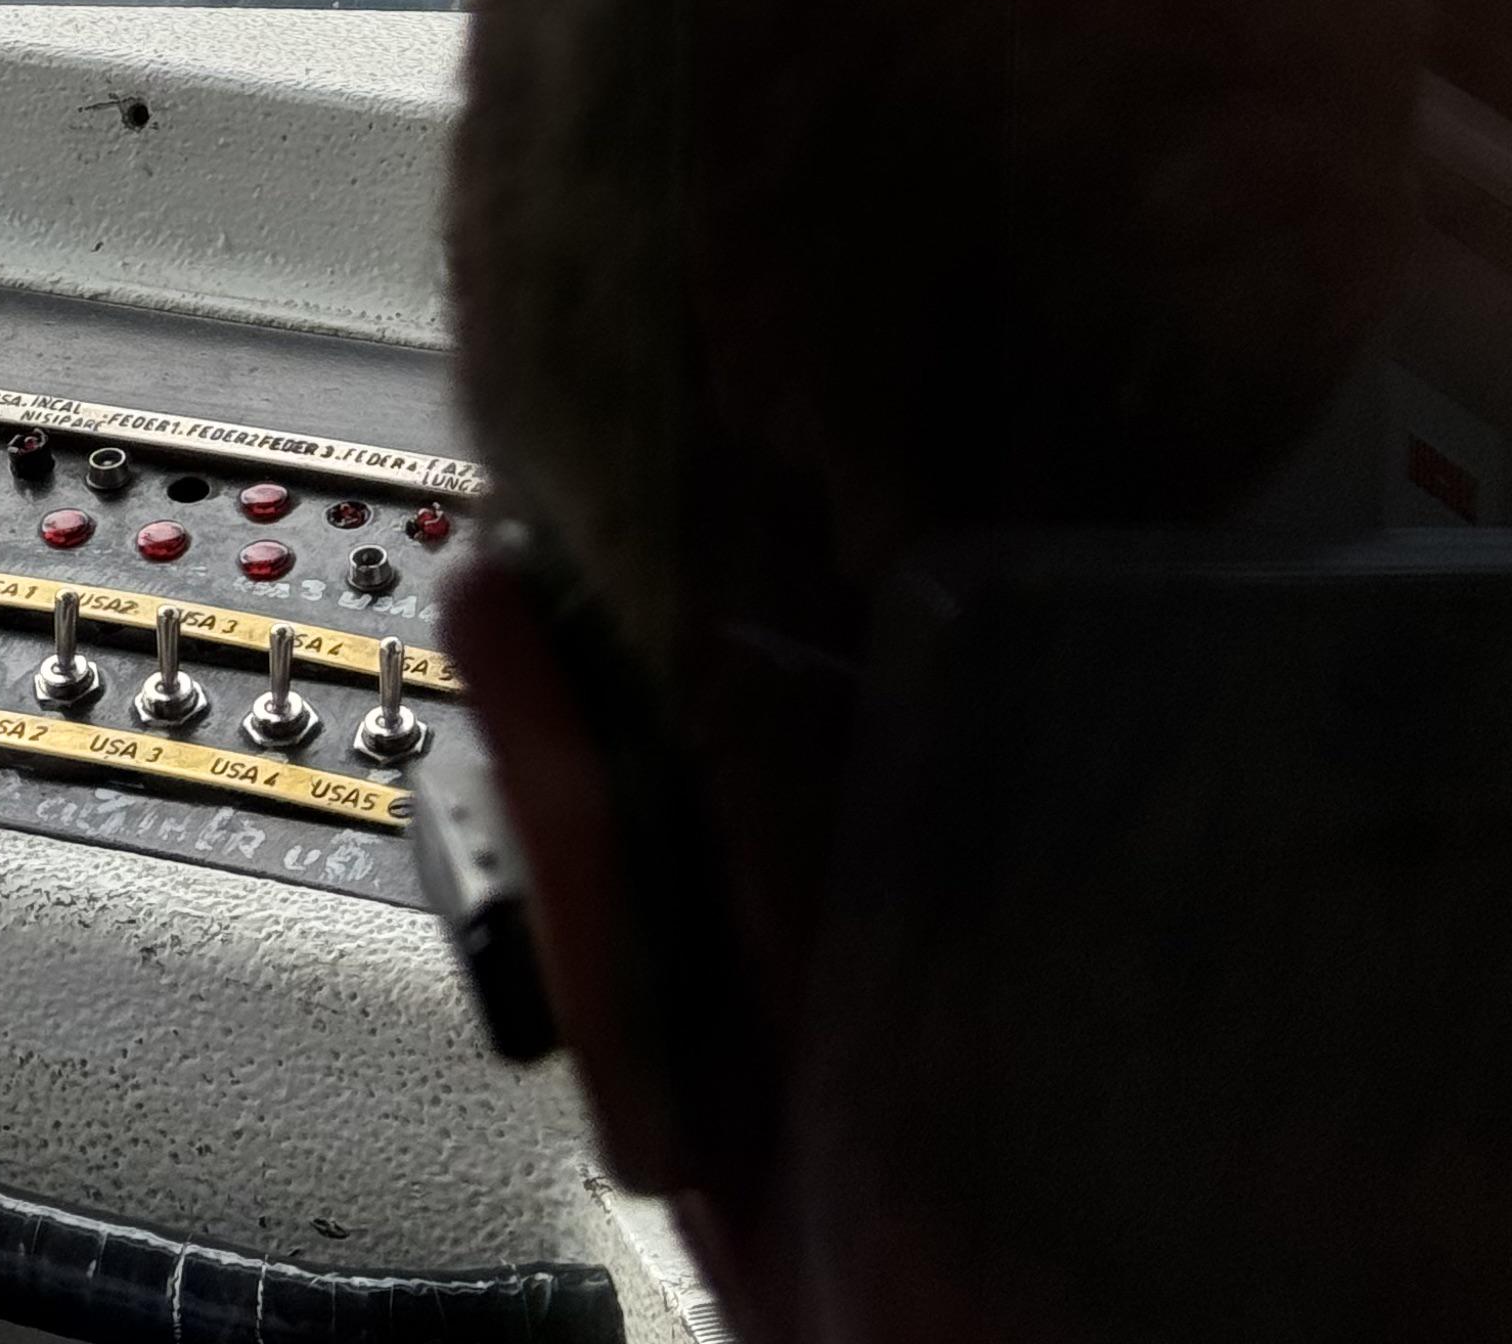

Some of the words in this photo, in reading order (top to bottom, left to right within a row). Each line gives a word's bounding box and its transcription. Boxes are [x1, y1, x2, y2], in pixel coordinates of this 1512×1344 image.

[31, 394, 82, 415] INCAL
[89, 734, 140, 760] USA
[145, 746, 164, 763] 3
[210, 757, 259, 785] USA
